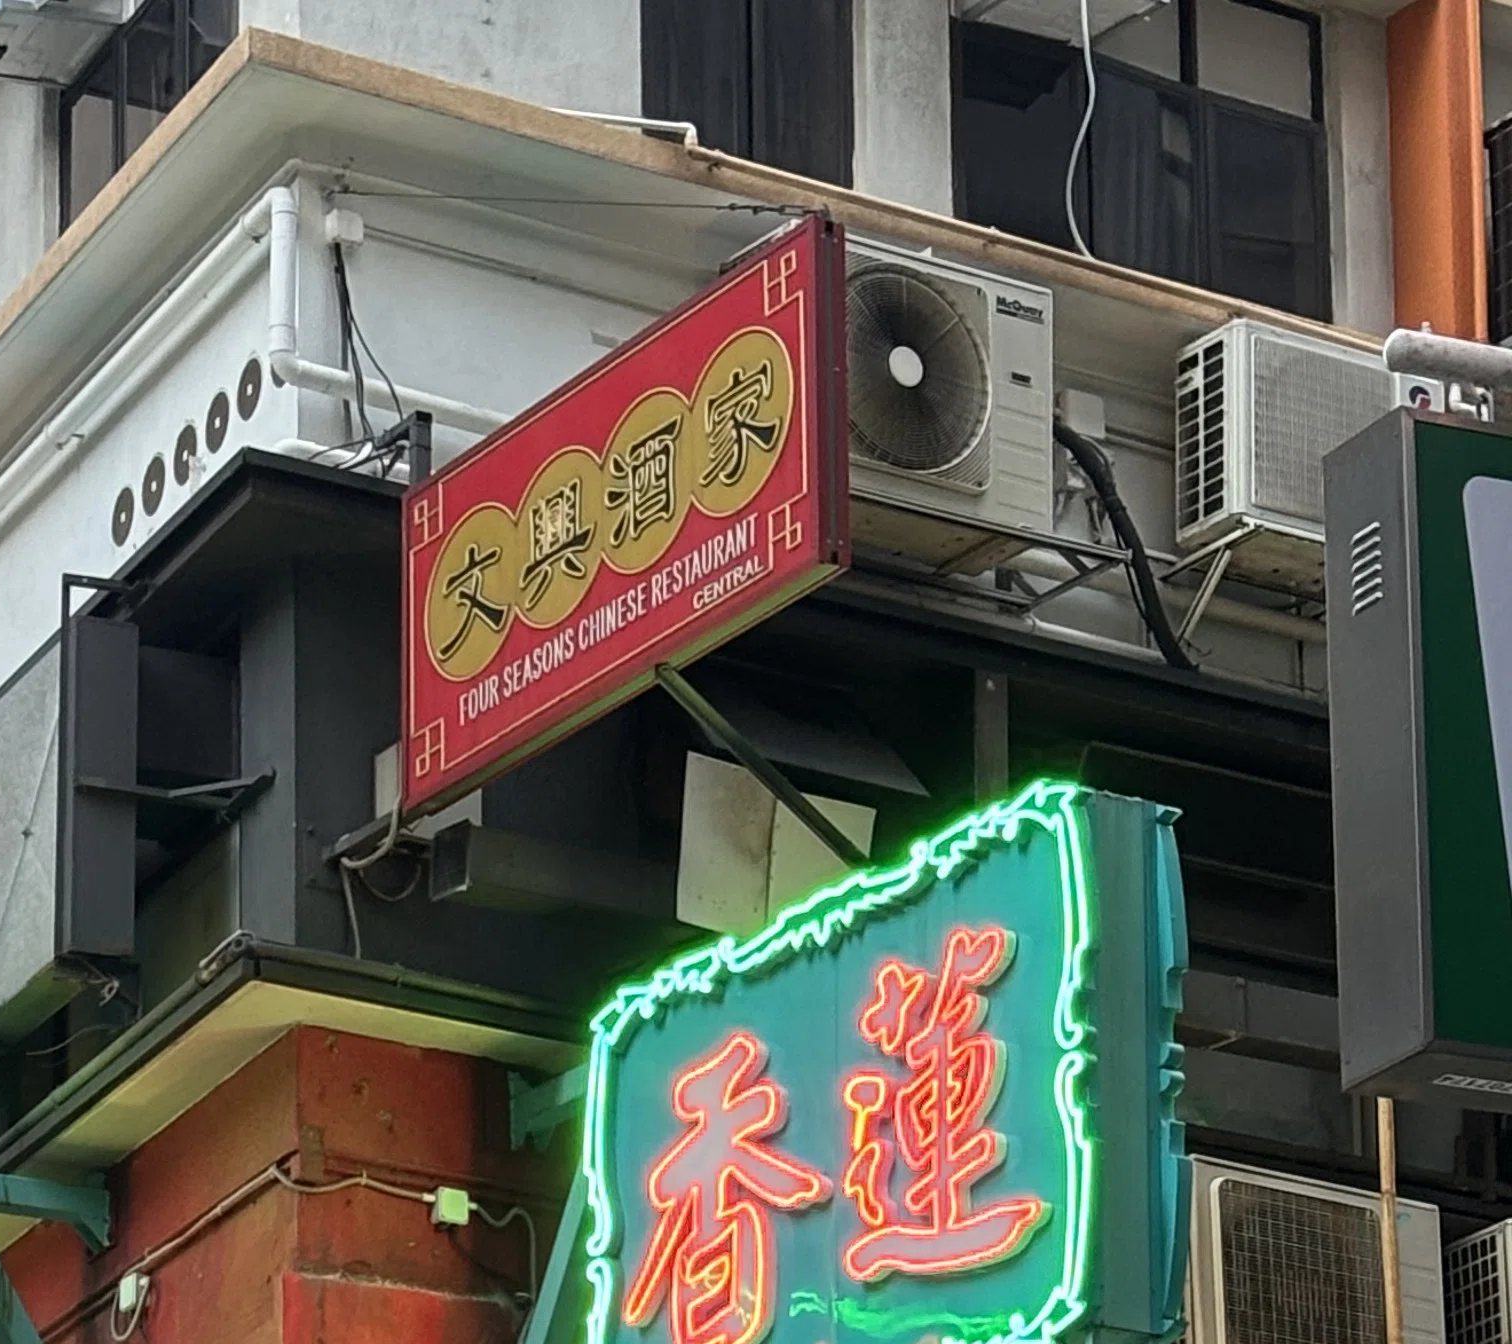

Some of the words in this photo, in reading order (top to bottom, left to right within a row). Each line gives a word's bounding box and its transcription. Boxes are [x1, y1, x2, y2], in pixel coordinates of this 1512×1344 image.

[437, 356, 783, 662] 文興酒家
[692, 555, 765, 610] CENTRAL
[458, 676, 500, 727] FOUR
[502, 627, 575, 698] SEASONS
[577, 581, 648, 652] CHINESE
[651, 512, 759, 609] RESTAURANT
